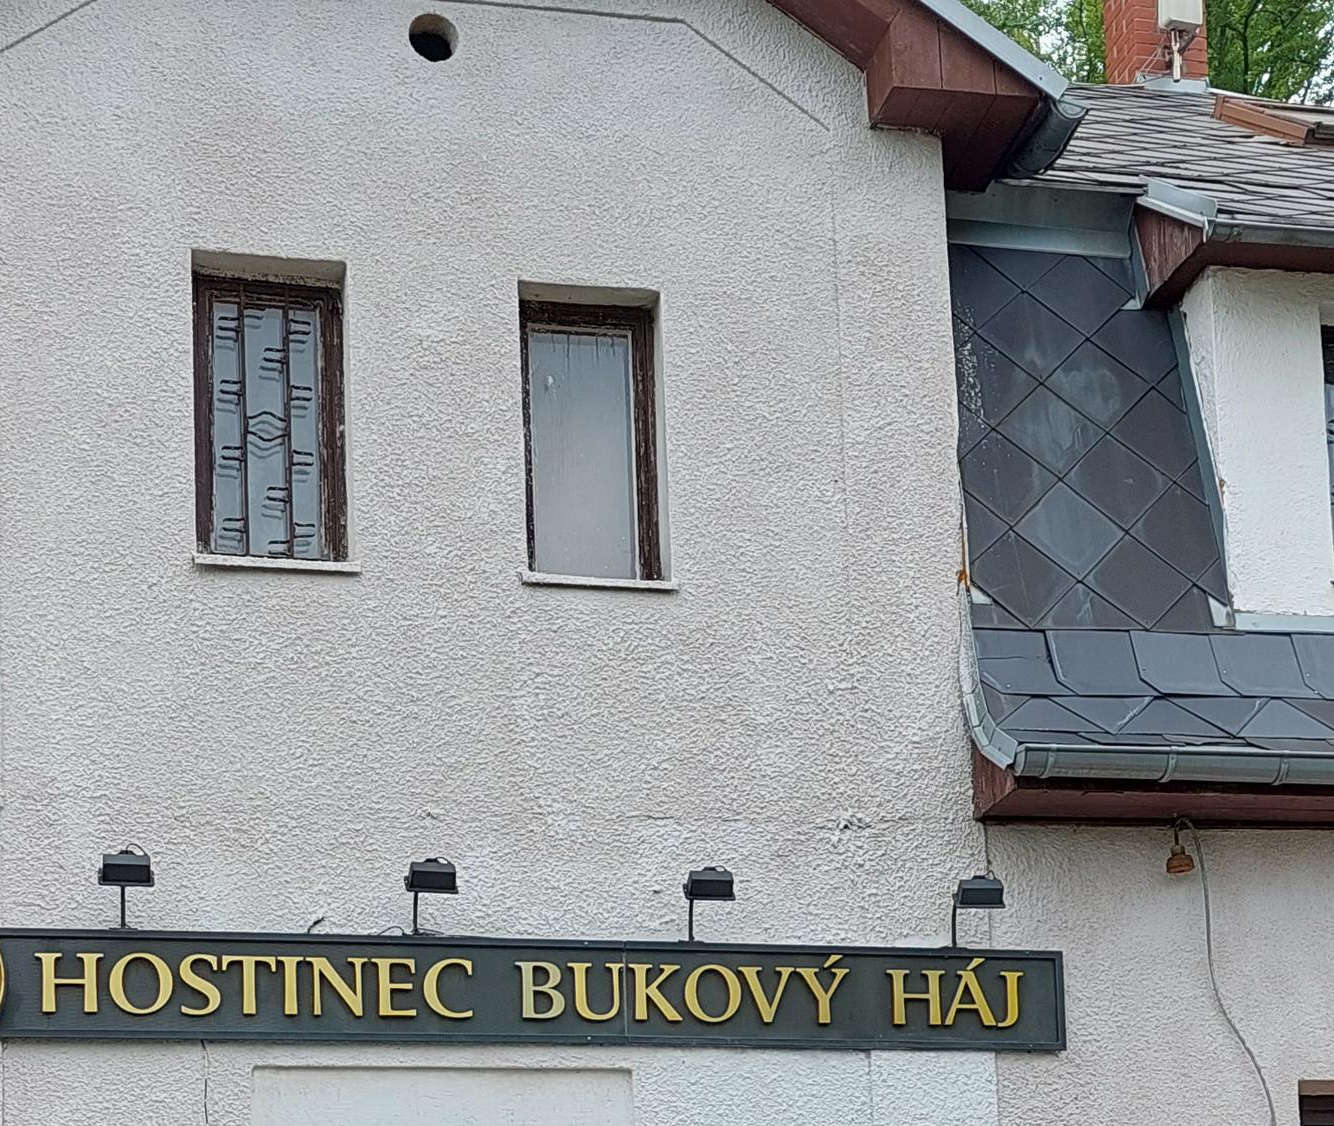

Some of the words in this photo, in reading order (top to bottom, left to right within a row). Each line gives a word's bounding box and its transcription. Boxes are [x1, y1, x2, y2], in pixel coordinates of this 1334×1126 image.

[34, 952, 474, 1019] HOSTINEC
[515, 955, 850, 1026] BUKOVÝ
[886, 957, 1025, 1030] HÁJ
